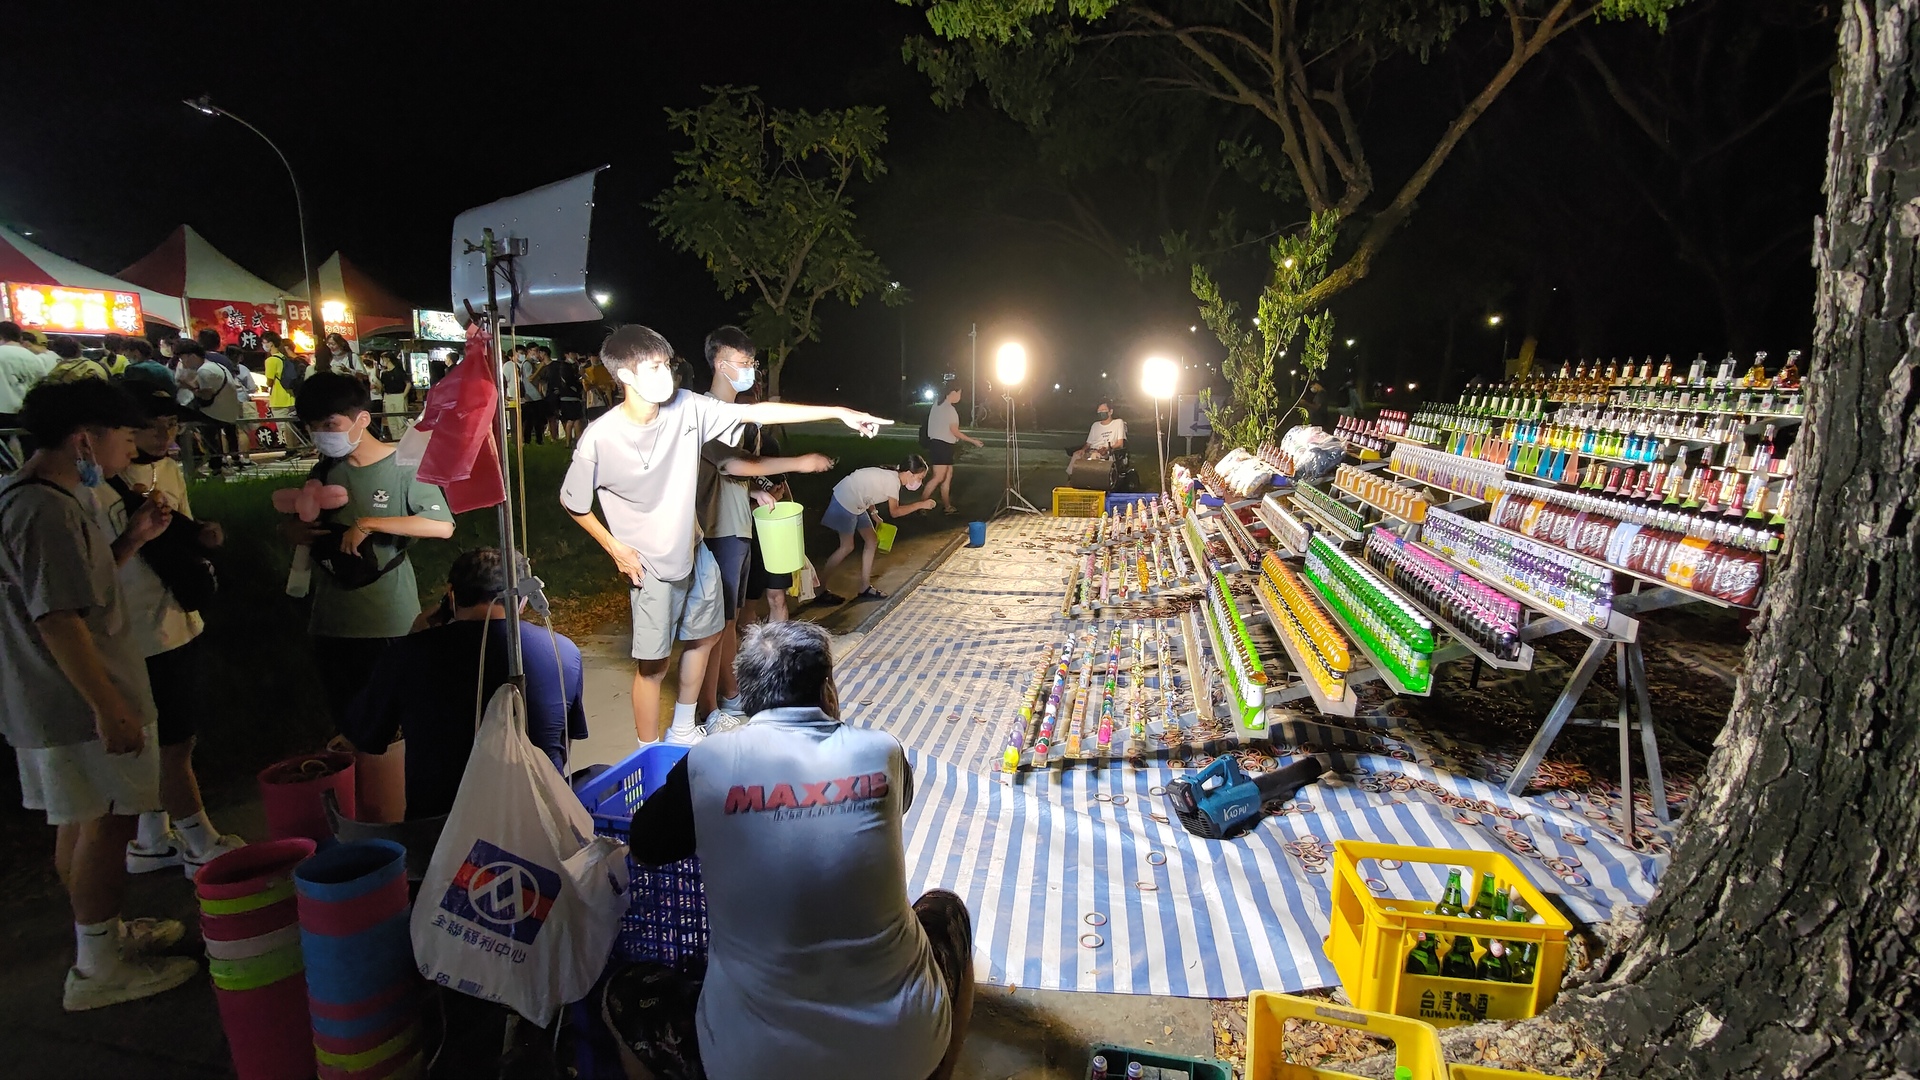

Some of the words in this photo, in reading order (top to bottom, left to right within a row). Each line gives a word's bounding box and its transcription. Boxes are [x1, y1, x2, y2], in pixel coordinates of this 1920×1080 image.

[724, 771, 889, 815] MAXXIS
[431, 914, 526, 963] 全聯福利中心
[1420, 1009, 1456, 1020] TAIWAN
